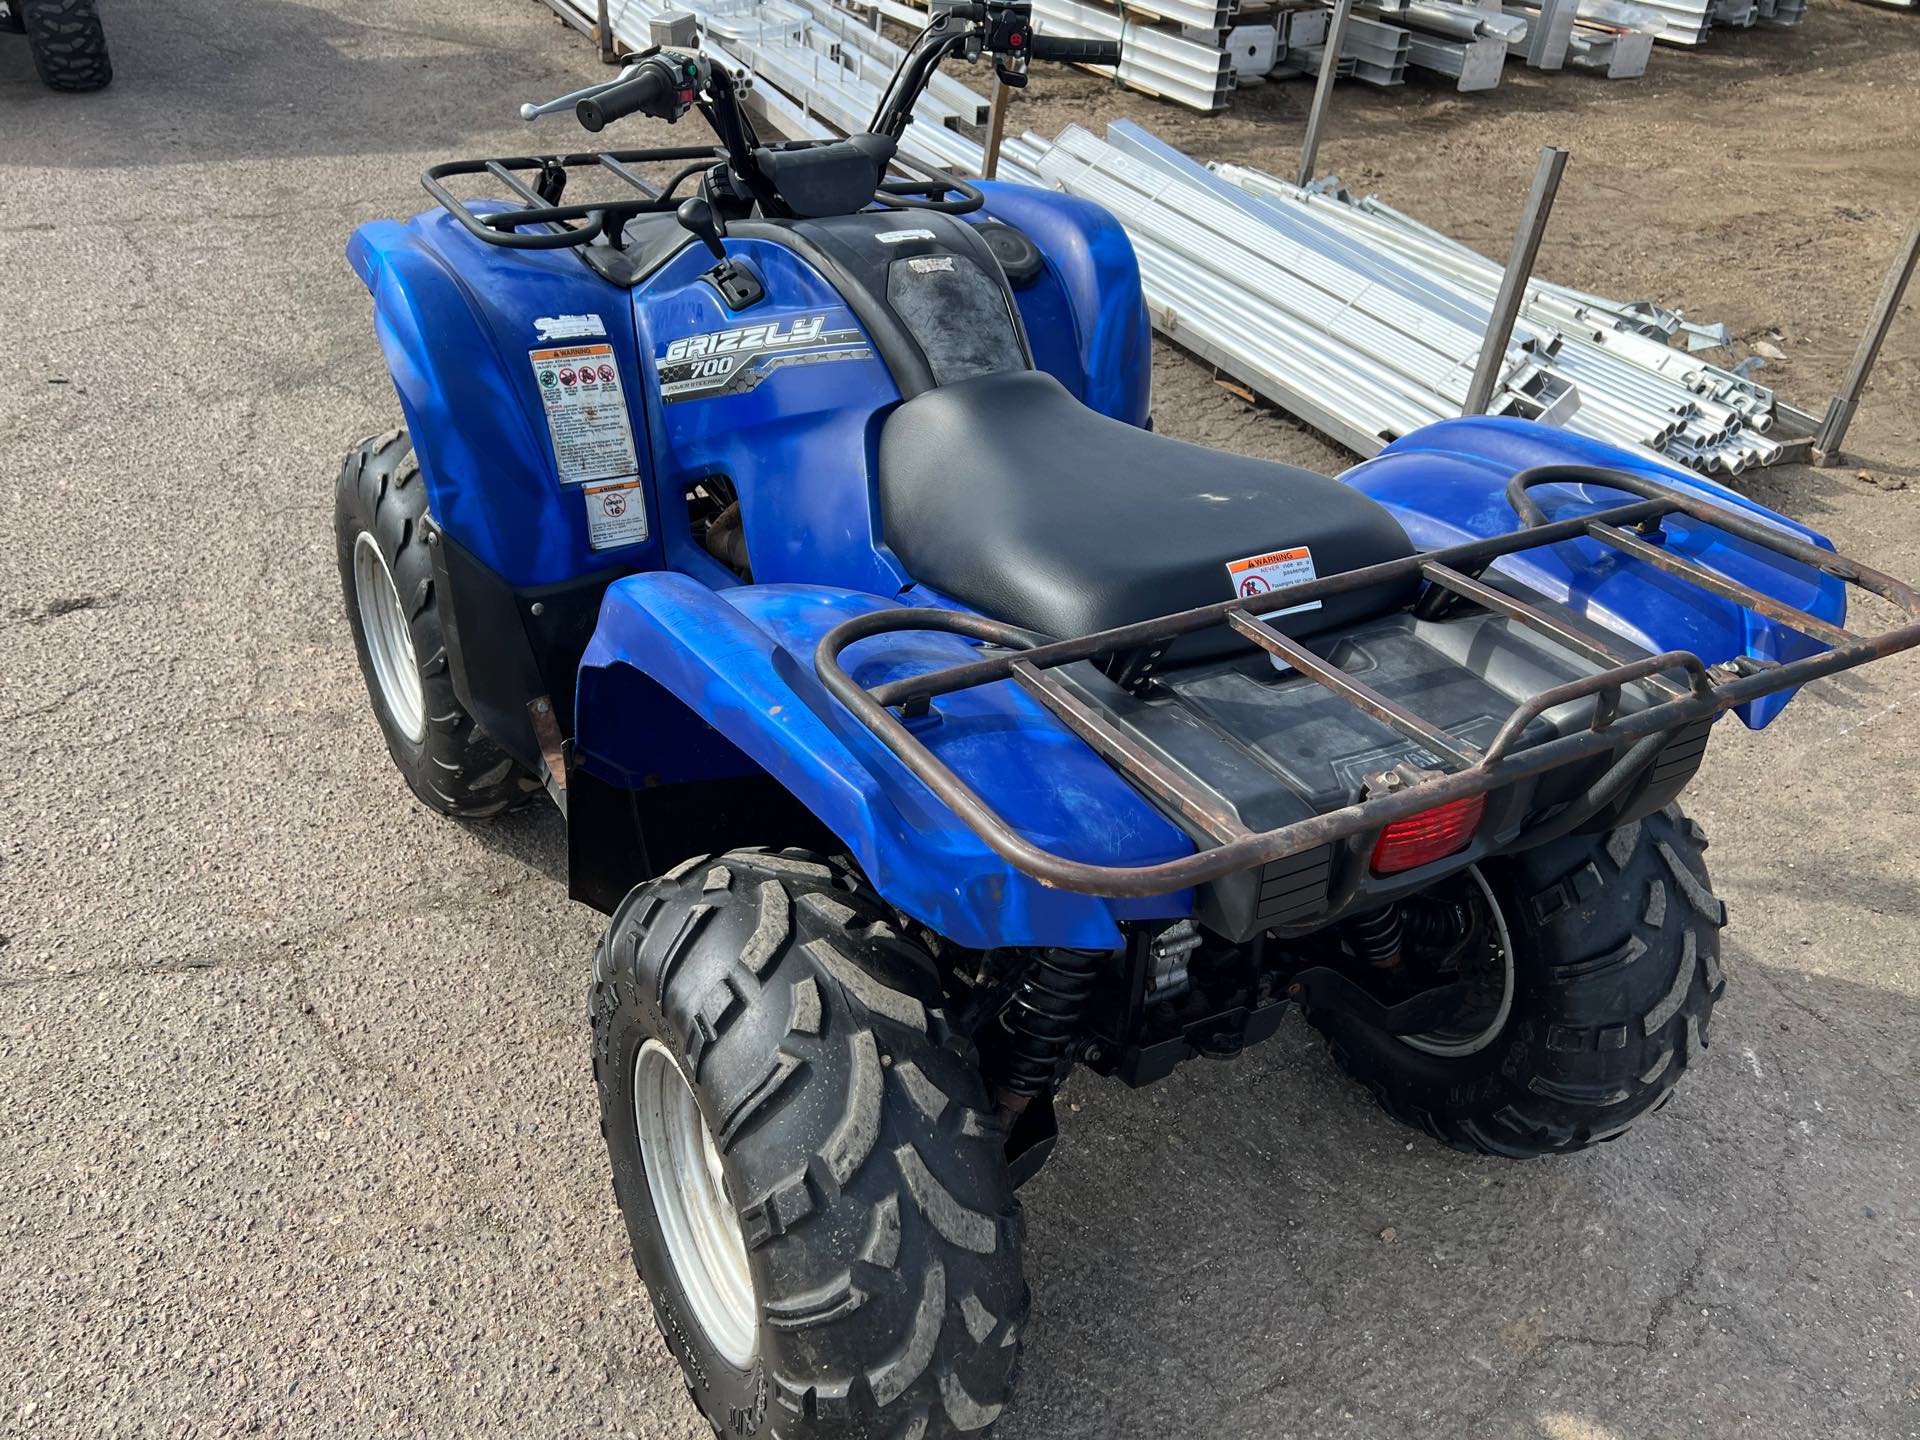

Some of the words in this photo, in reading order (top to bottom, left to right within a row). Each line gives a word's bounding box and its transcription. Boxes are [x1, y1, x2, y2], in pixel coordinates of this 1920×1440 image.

[666, 317, 825, 364] GRIZZLY
[560, 348, 591, 356] WARNING
[691, 356, 735, 380] 700
[668, 382, 690, 392] POWER
[690, 378, 725, 389] STEERING
[610, 507, 620, 515] 16
[1255, 552, 1293, 567] WARNING
[1260, 565, 1280, 573] NEVER
[1283, 566, 1310, 576] passenger
